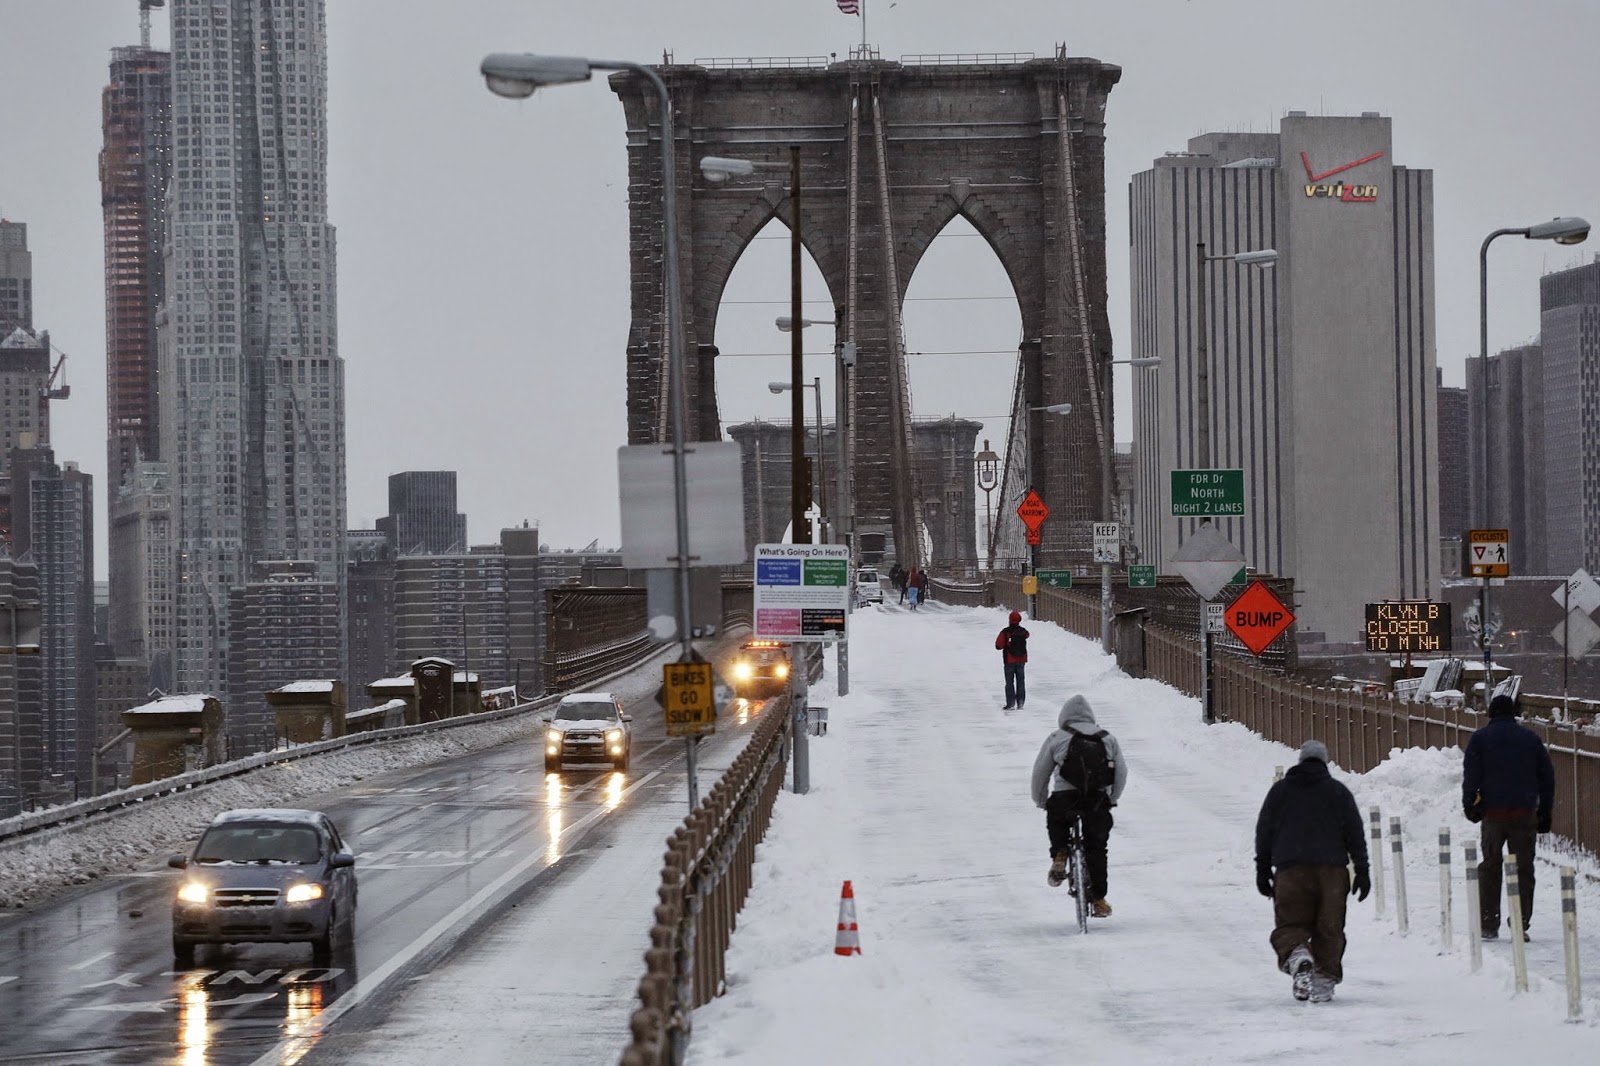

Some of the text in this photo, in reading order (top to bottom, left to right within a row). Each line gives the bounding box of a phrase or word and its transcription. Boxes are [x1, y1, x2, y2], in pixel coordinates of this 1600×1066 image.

[1304, 181, 1378, 202] verizon
[1190, 474, 1224, 484] FDR Dr
[1191, 487, 1225, 498] NORTH
[1173, 501, 1242, 513] RIGHT 2 LANES
[1096, 526, 1116, 536] KEEP
[1473, 532, 1505, 540] CYCLISTS
[759, 548, 785, 556] What's
[787, 548, 810, 557] Going
[812, 548, 823, 556] On
[1378, 604, 1439, 619] KLYN B
[1236, 611, 1283, 627] BUMP
[1367, 620, 1429, 635] CLOSED
[1368, 635, 1439, 650] TO M NH
[671, 671, 705, 686] BIKES
[681, 690, 698, 704] GO
[670, 709, 703, 723] SLOW
